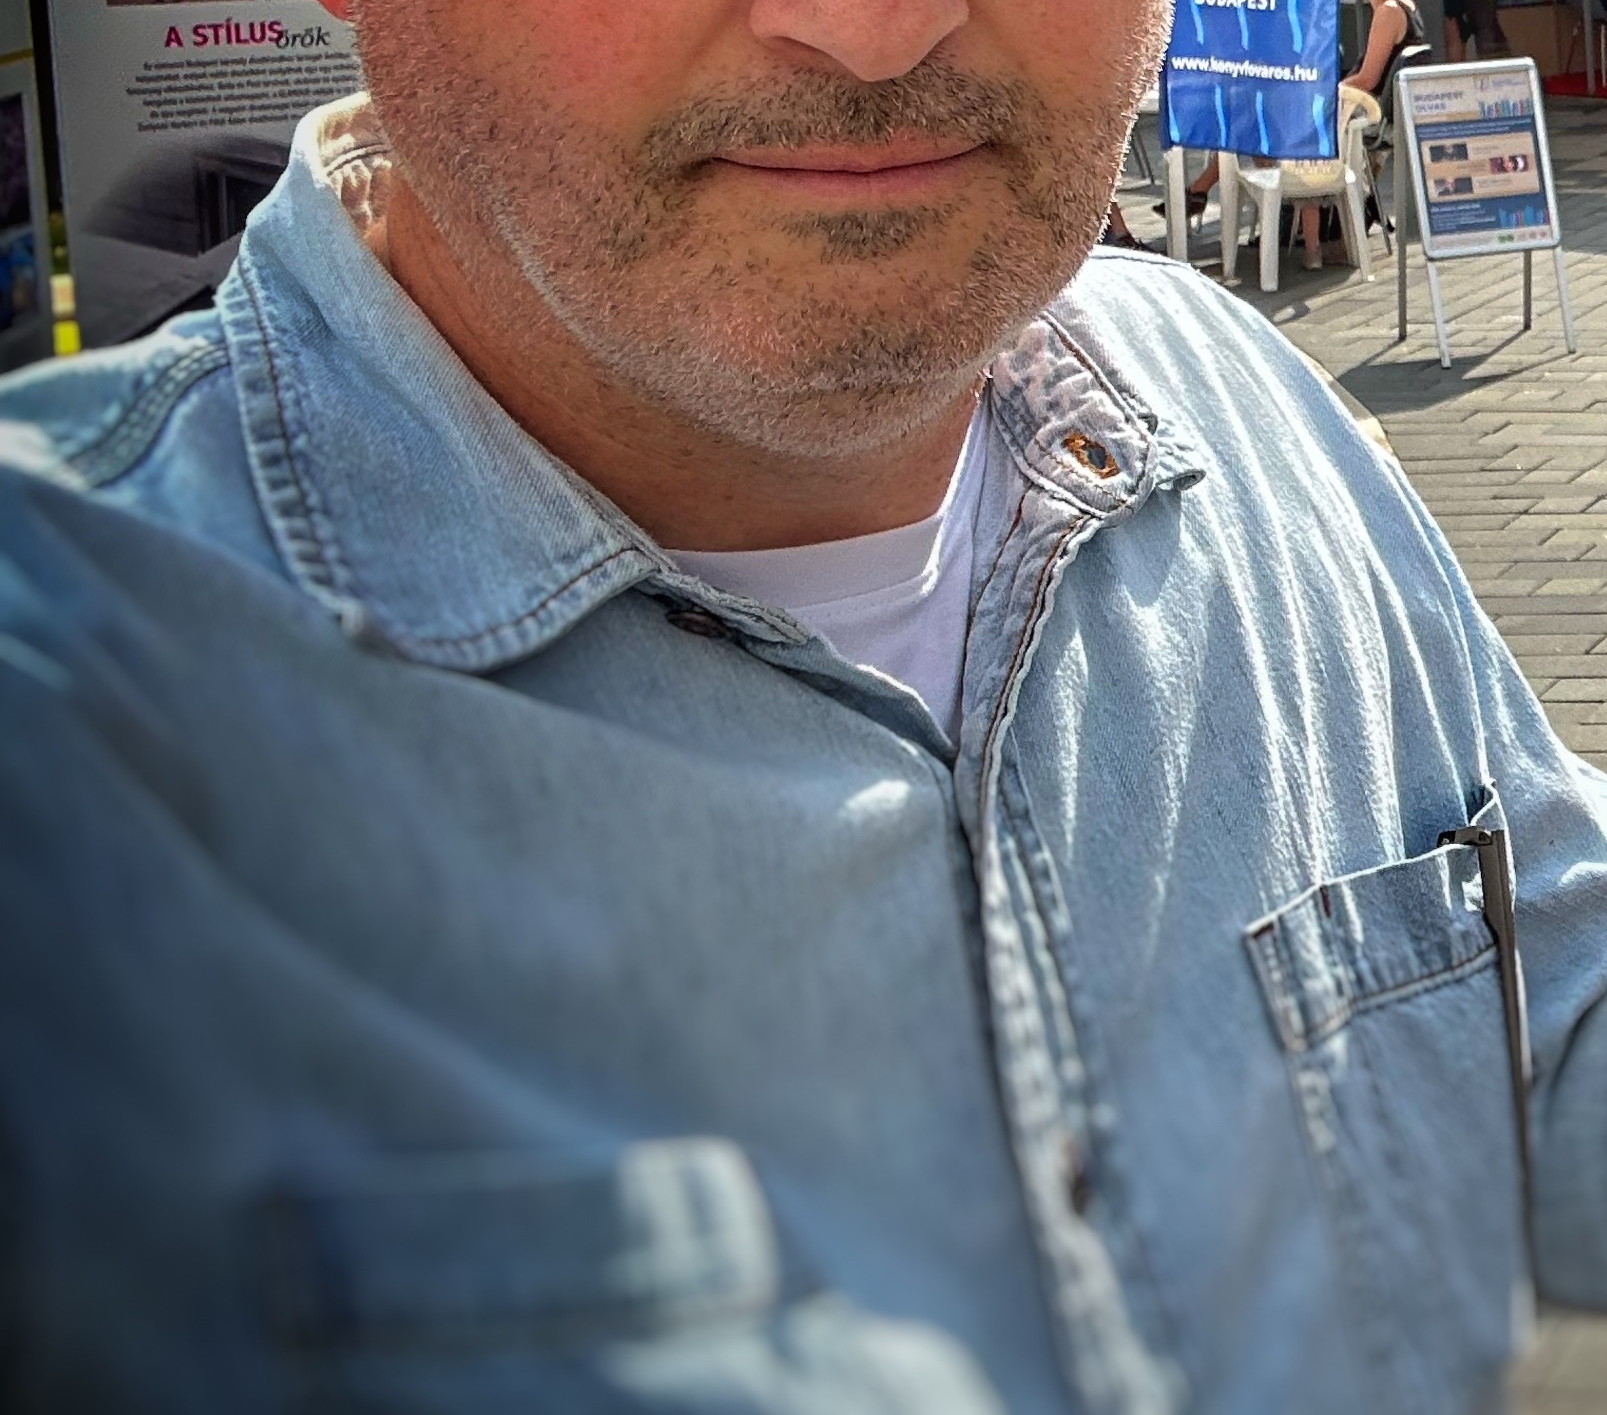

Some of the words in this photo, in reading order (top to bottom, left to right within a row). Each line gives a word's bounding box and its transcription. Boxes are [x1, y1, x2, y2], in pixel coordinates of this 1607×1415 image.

[164, 26, 184, 48] A
[192, 16, 283, 47] STÍLUS
[1171, 55, 1318, 82] www.konyvfovaros.hu
